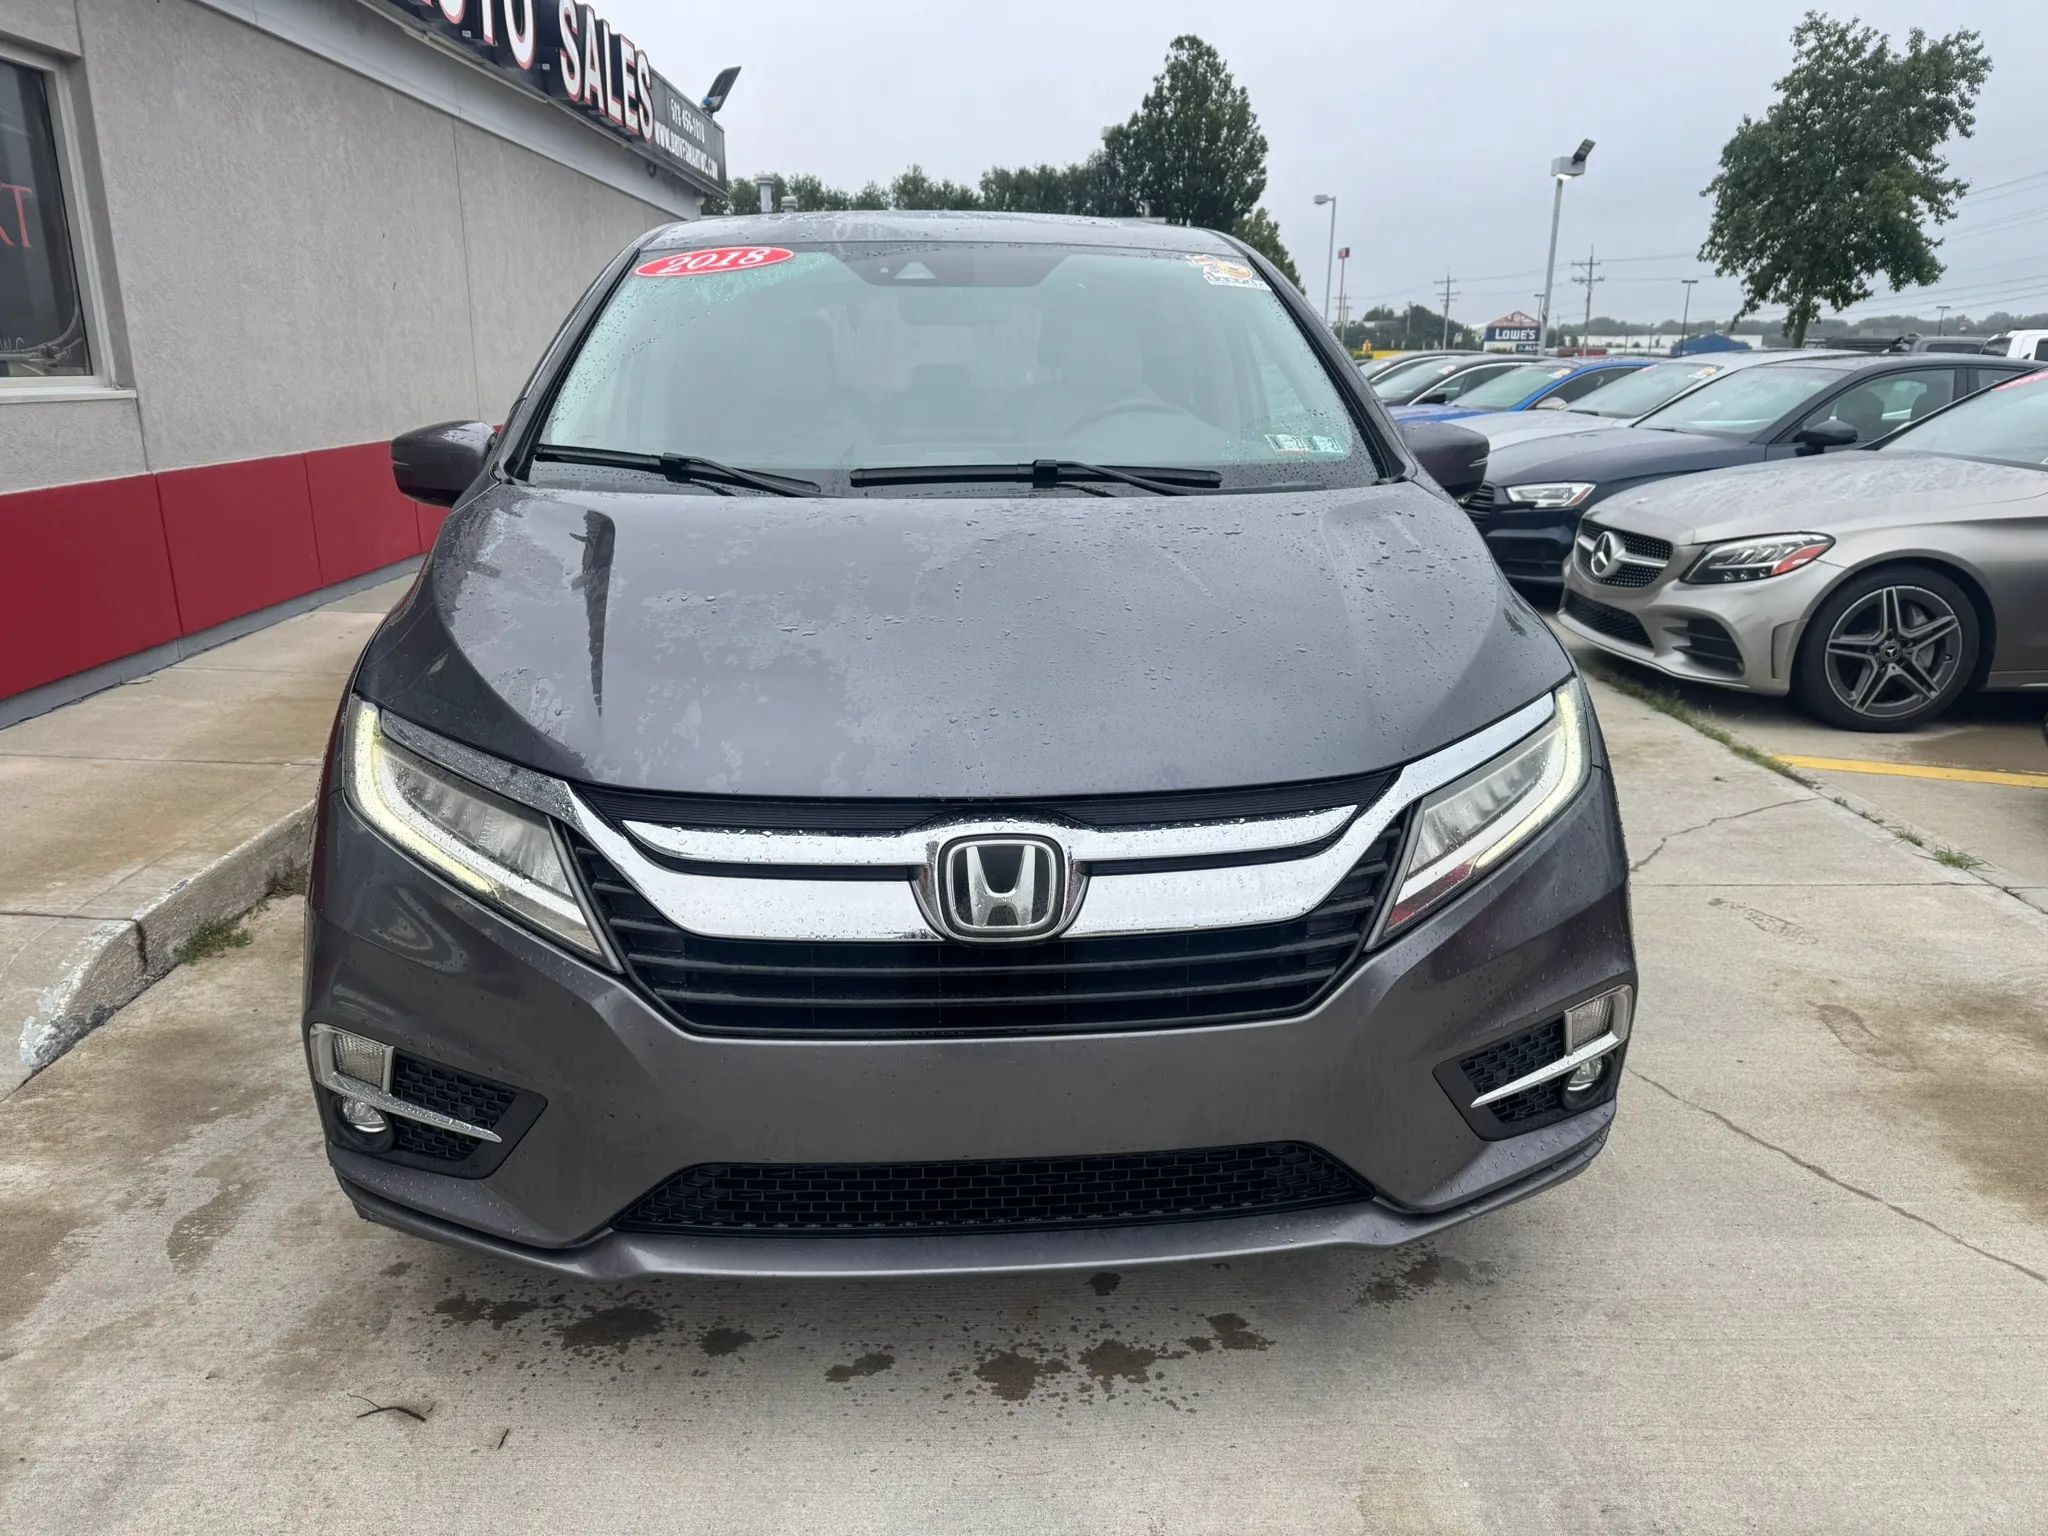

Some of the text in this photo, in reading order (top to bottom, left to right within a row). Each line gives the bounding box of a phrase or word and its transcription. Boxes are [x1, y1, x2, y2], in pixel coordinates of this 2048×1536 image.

[558, 0, 654, 144] SALES
[656, 248, 771, 275] 2018
[1495, 327, 1536, 340] LOWE'S
